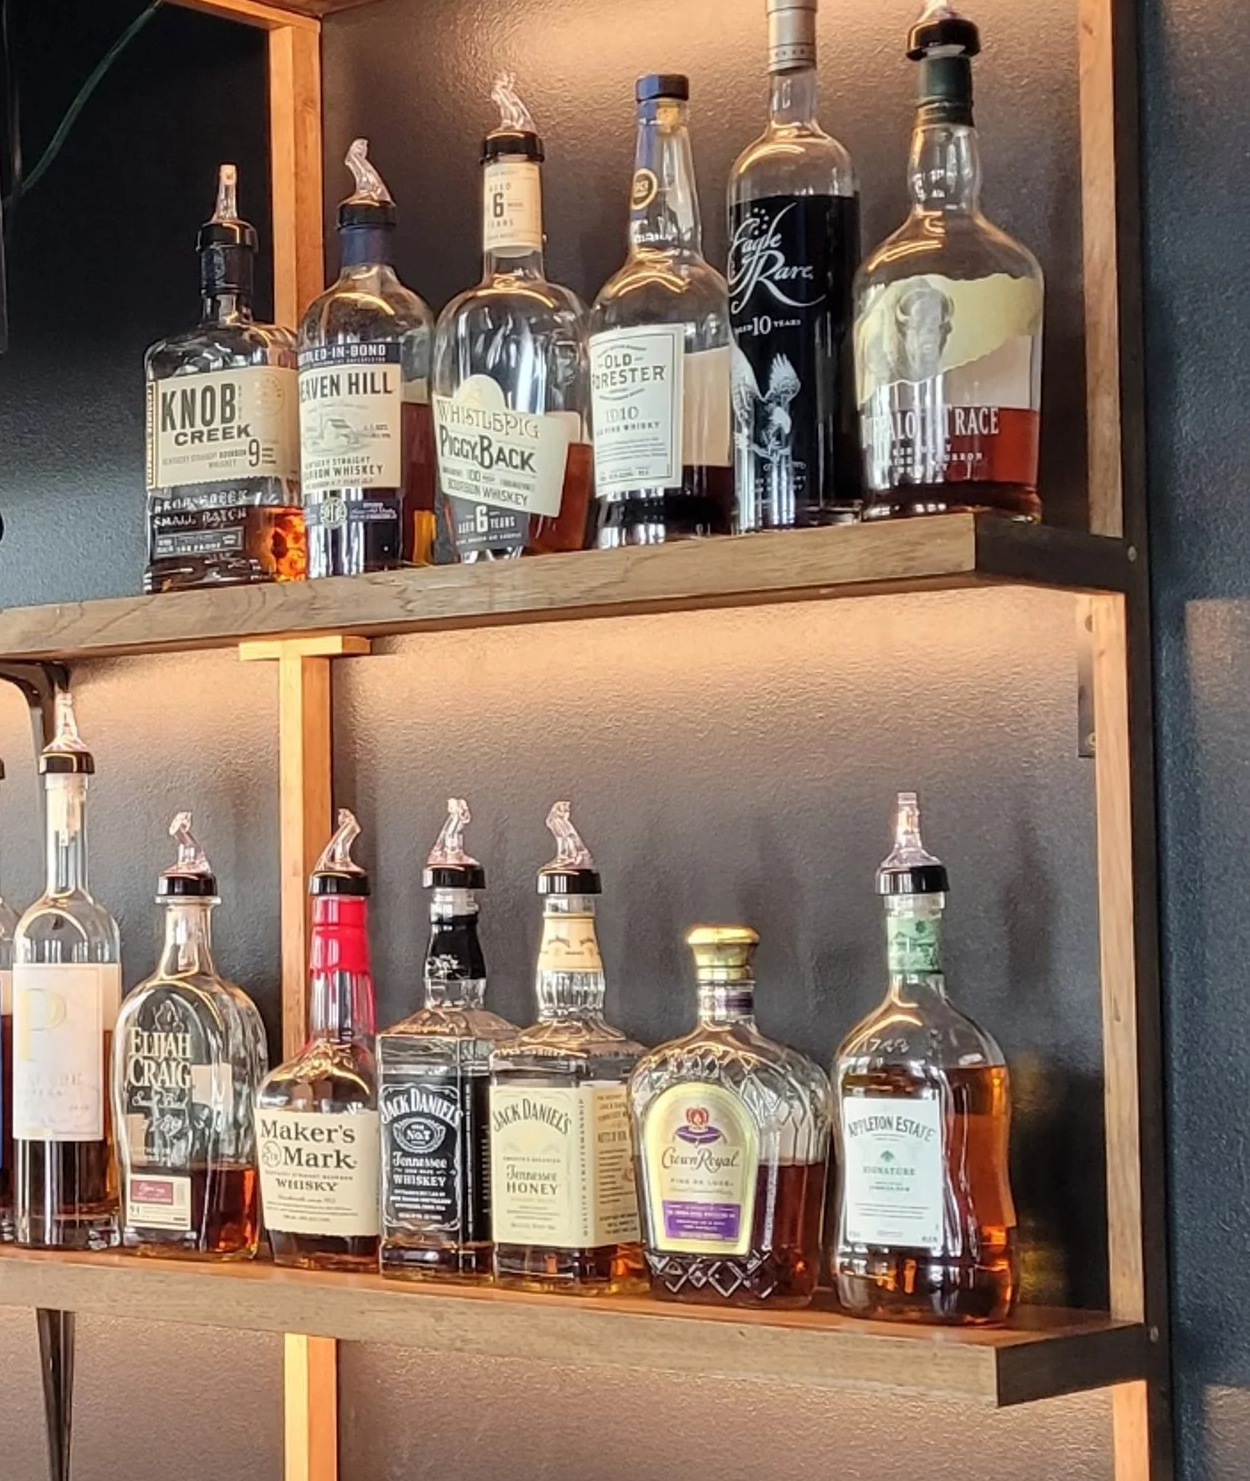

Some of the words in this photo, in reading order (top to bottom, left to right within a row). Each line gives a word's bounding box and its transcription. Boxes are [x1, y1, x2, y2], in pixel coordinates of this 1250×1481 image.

[492, 190, 505, 219] 6
[752, 315, 772, 336] 10
[604, 353, 633, 368] OLD
[348, 371, 393, 396] HILL
[161, 382, 236, 432] KNOB
[174, 424, 251, 446] CREEK
[623, 422, 661, 432] WHISKY
[248, 438, 260, 467] 9
[334, 464, 384, 476] WHISKEY
[483, 487, 530, 507] WHISKEY
[475, 505, 489, 532] 6
[130, 1026, 193, 1060] ELIJAH
[129, 1054, 193, 1089] CRAIG
[379, 1094, 410, 1125] JACK
[410, 1087, 464, 1129] DANIEL'S
[492, 1102, 522, 1133] JACK
[523, 1097, 572, 1135] DANIEL'S
[261, 1119, 356, 1144] Maker's
[849, 1115, 894, 1139] APPLETON
[896, 1116, 937, 1142] ESTATE
[283, 1146, 356, 1170] Mark
[393, 1151, 448, 1169] Tennessee
[661, 1146, 698, 1170] Crown
[694, 1148, 740, 1173] Royal
[393, 1174, 447, 1187] WHISKEY
[506, 1164, 558, 1182] Tennessee
[862, 1166, 916, 1176] SIGNATURE
[275, 1178, 339, 1192] WHISKY
[506, 1182, 559, 1195] HONEY
